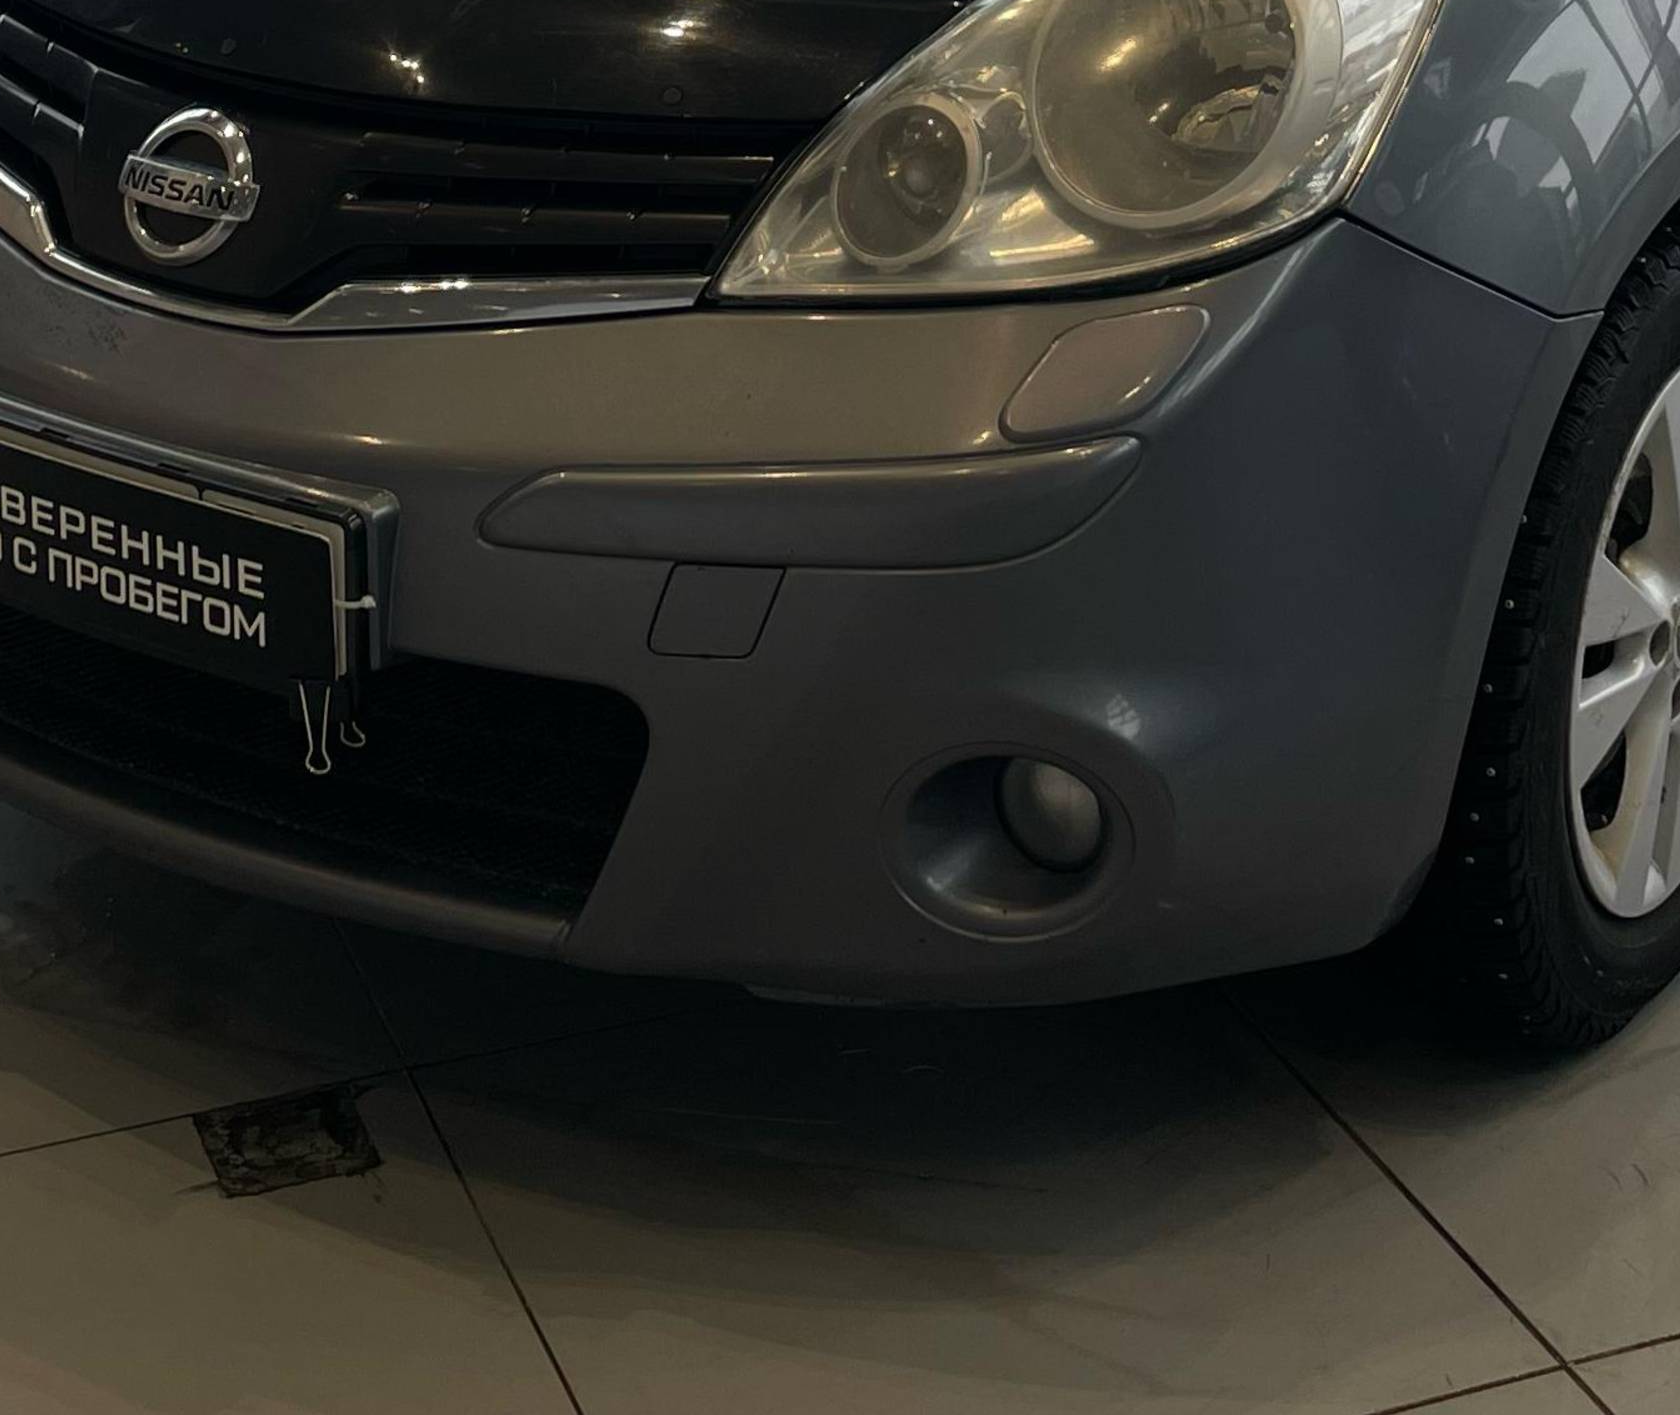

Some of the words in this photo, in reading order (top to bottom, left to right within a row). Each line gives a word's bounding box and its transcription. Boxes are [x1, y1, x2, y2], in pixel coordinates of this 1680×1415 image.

[125, 167, 234, 210] NISSAN
[13, 536, 38, 575] С
[47, 548, 267, 649] ПРОБЕГОМ
